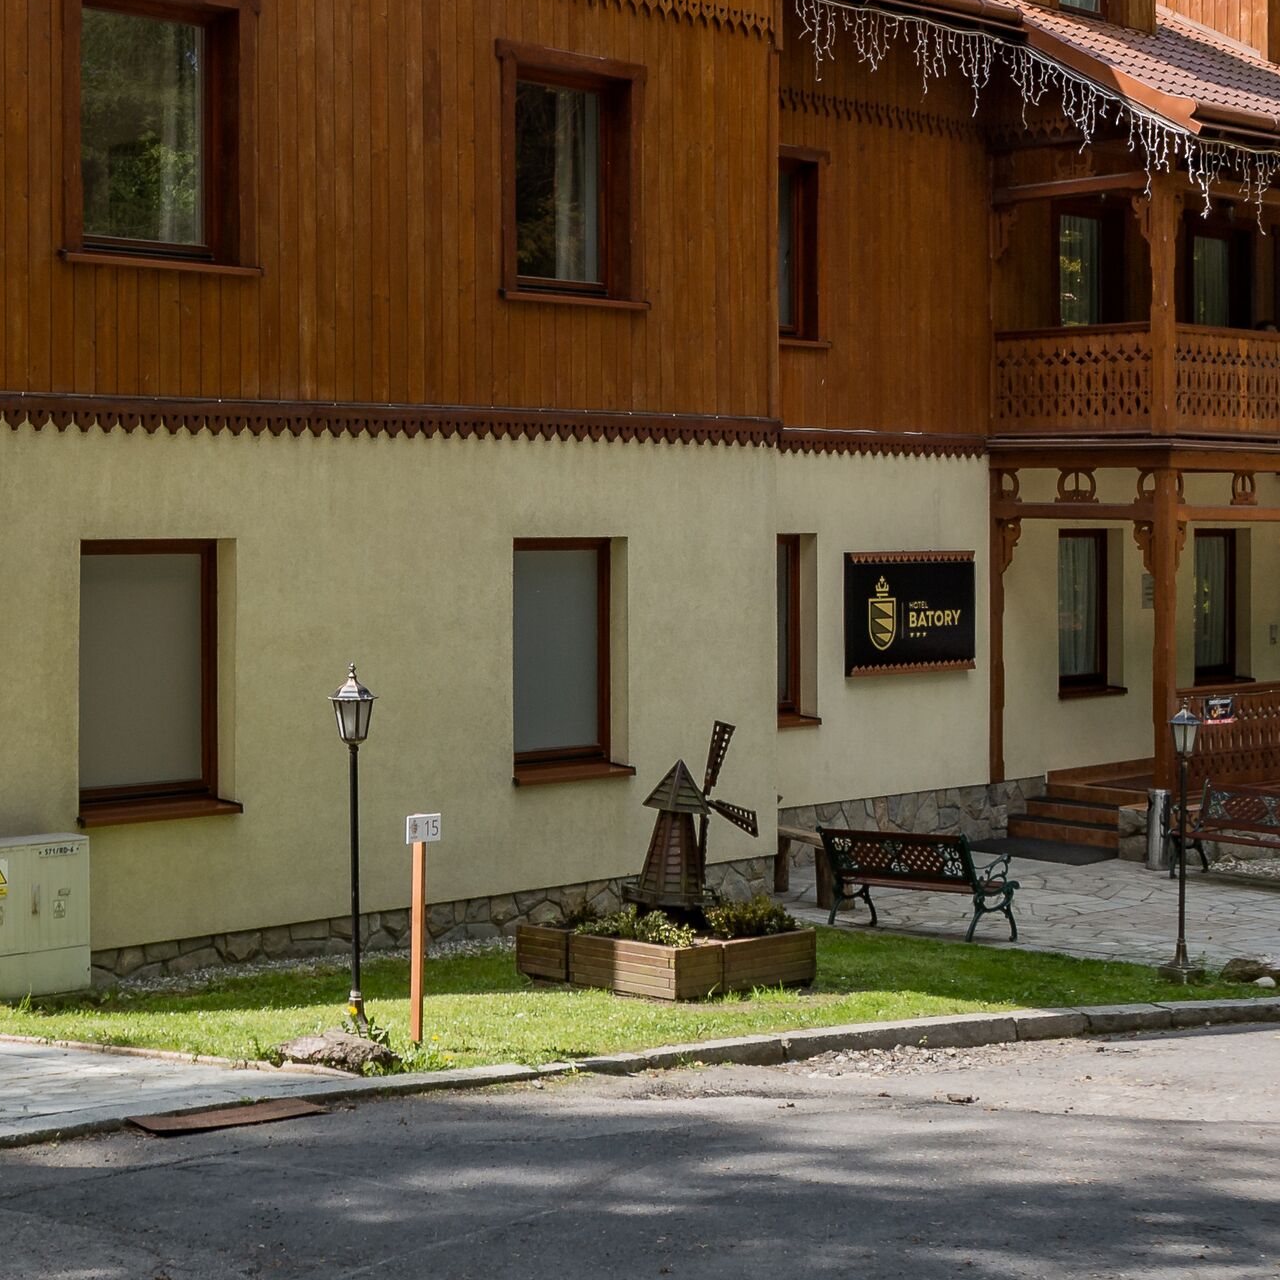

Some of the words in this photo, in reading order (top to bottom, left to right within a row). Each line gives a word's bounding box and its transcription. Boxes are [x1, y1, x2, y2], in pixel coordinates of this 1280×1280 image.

[909, 601, 928, 609] HOTEL
[909, 610, 961, 627] BATORY
[424, 819, 439, 837] 15
